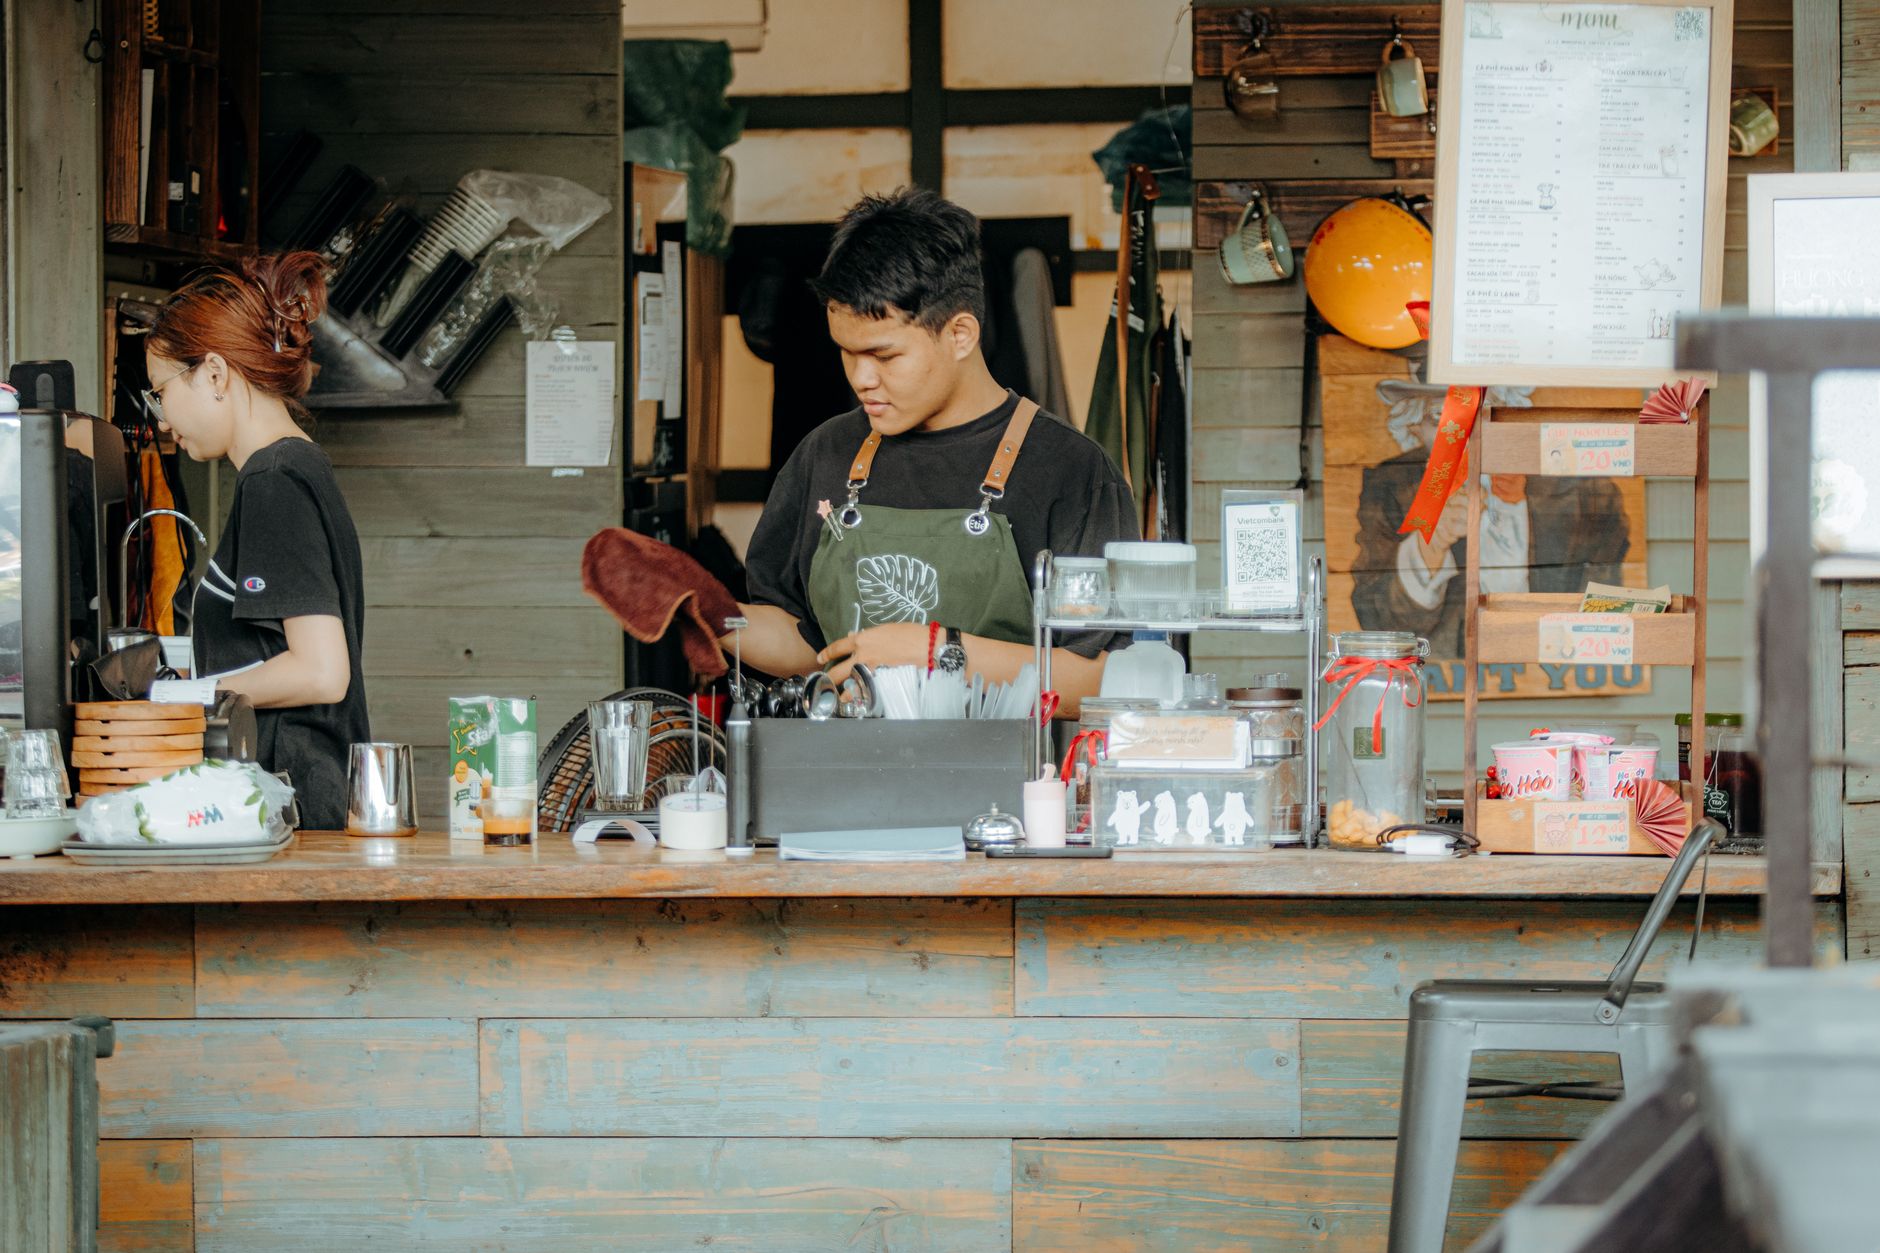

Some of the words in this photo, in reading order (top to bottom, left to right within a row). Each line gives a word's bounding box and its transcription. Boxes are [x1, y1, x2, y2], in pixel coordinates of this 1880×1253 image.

[1561, 11, 1619, 31] menu
[1578, 636, 1611, 657] 20
[1539, 663, 1644, 691] YOU
